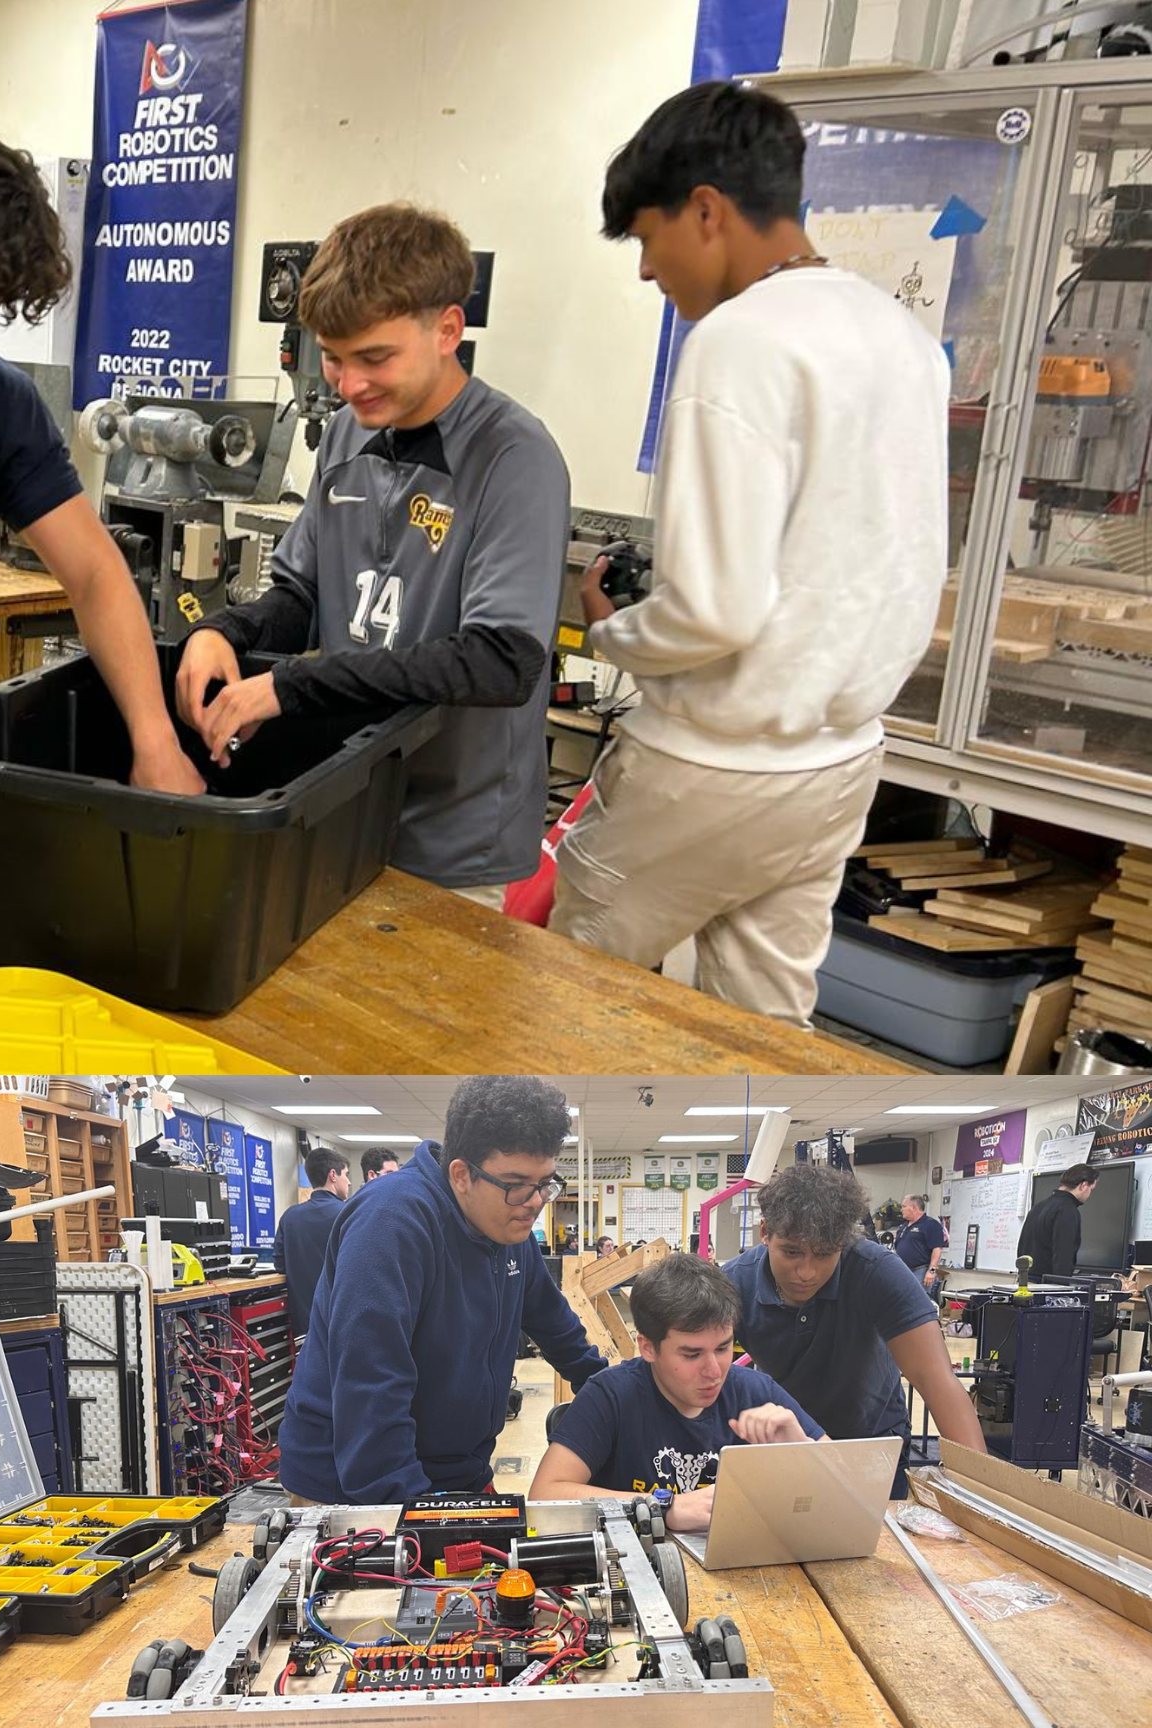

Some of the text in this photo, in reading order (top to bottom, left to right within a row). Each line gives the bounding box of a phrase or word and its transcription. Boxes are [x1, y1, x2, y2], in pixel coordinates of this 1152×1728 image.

[134, 93, 204, 129] FIRST
[118, 124, 218, 158] ROBOTICS
[102, 153, 235, 188] COMPETITION
[95, 220, 230, 248] AUTONOMOUS
[125, 258, 194, 283] AWARD
[130, 328, 170, 349] 2022
[98, 354, 212, 377] ROCKET CITY
[111, 382, 186, 398] REGIONA
[348, 569, 404, 651] 14
[974, 1121, 1006, 1138] ROBOTICON
[415, 1499, 511, 1508] DURACELL
